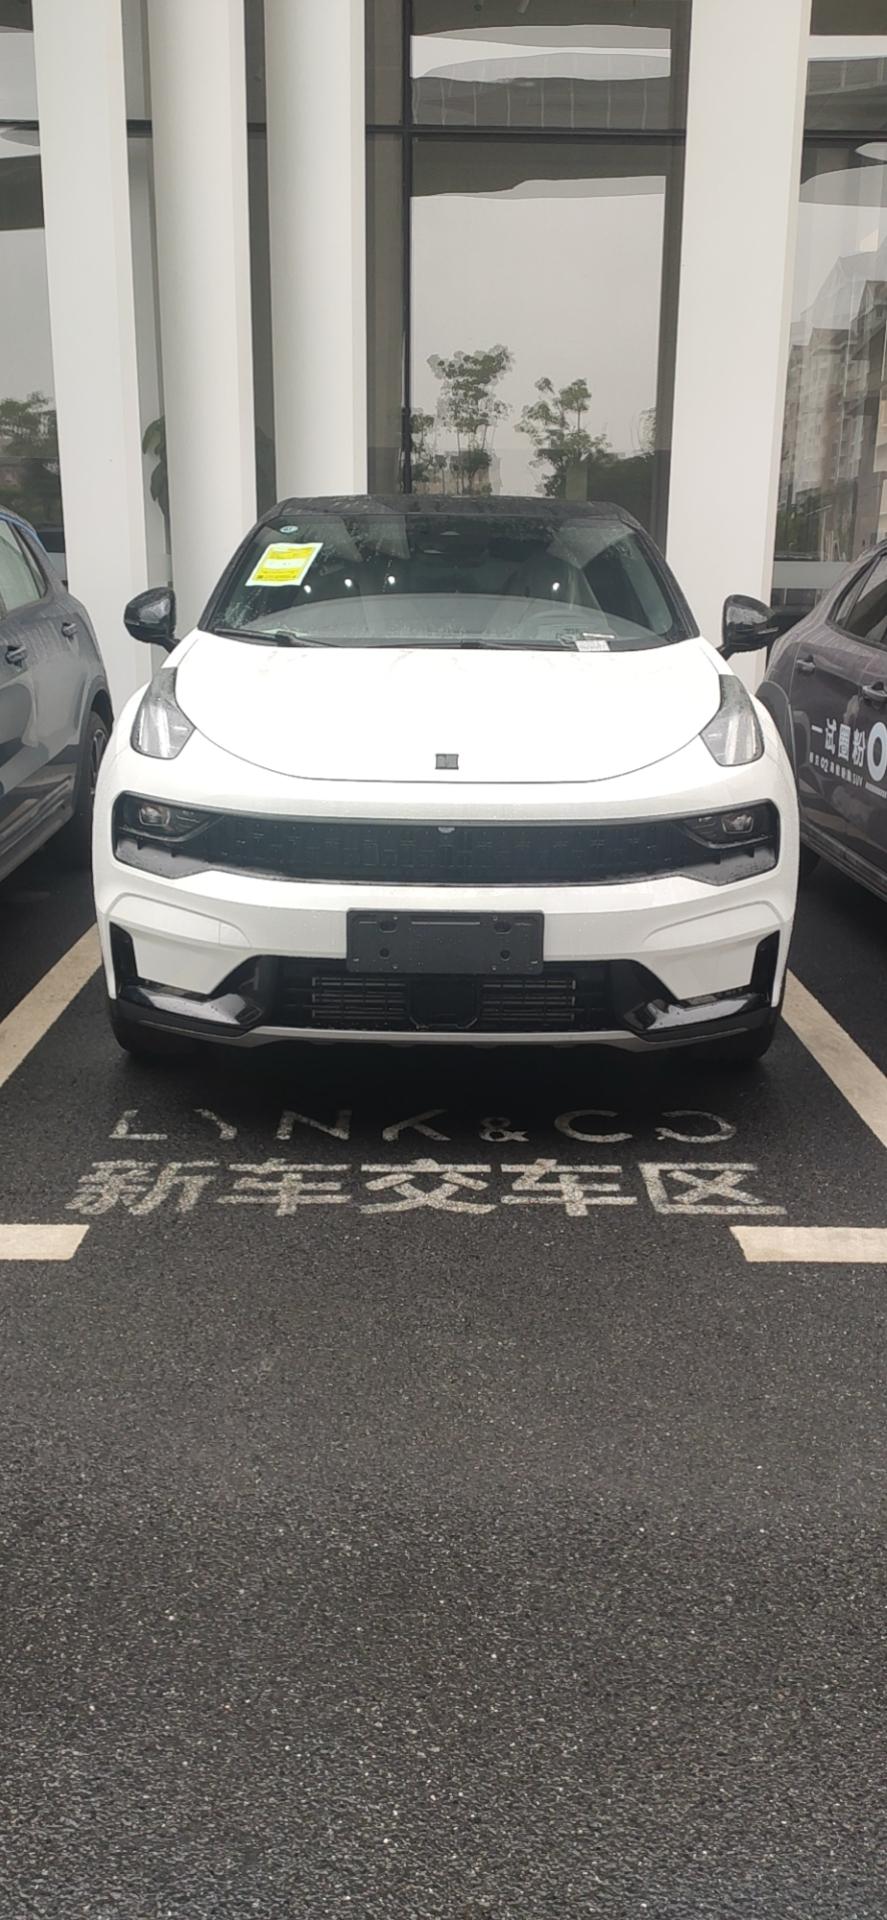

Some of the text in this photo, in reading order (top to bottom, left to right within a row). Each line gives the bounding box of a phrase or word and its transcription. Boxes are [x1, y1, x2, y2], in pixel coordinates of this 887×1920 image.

[811, 718, 866, 767] 一试圈粉
[64, 1158, 787, 1216] 新车交车区
